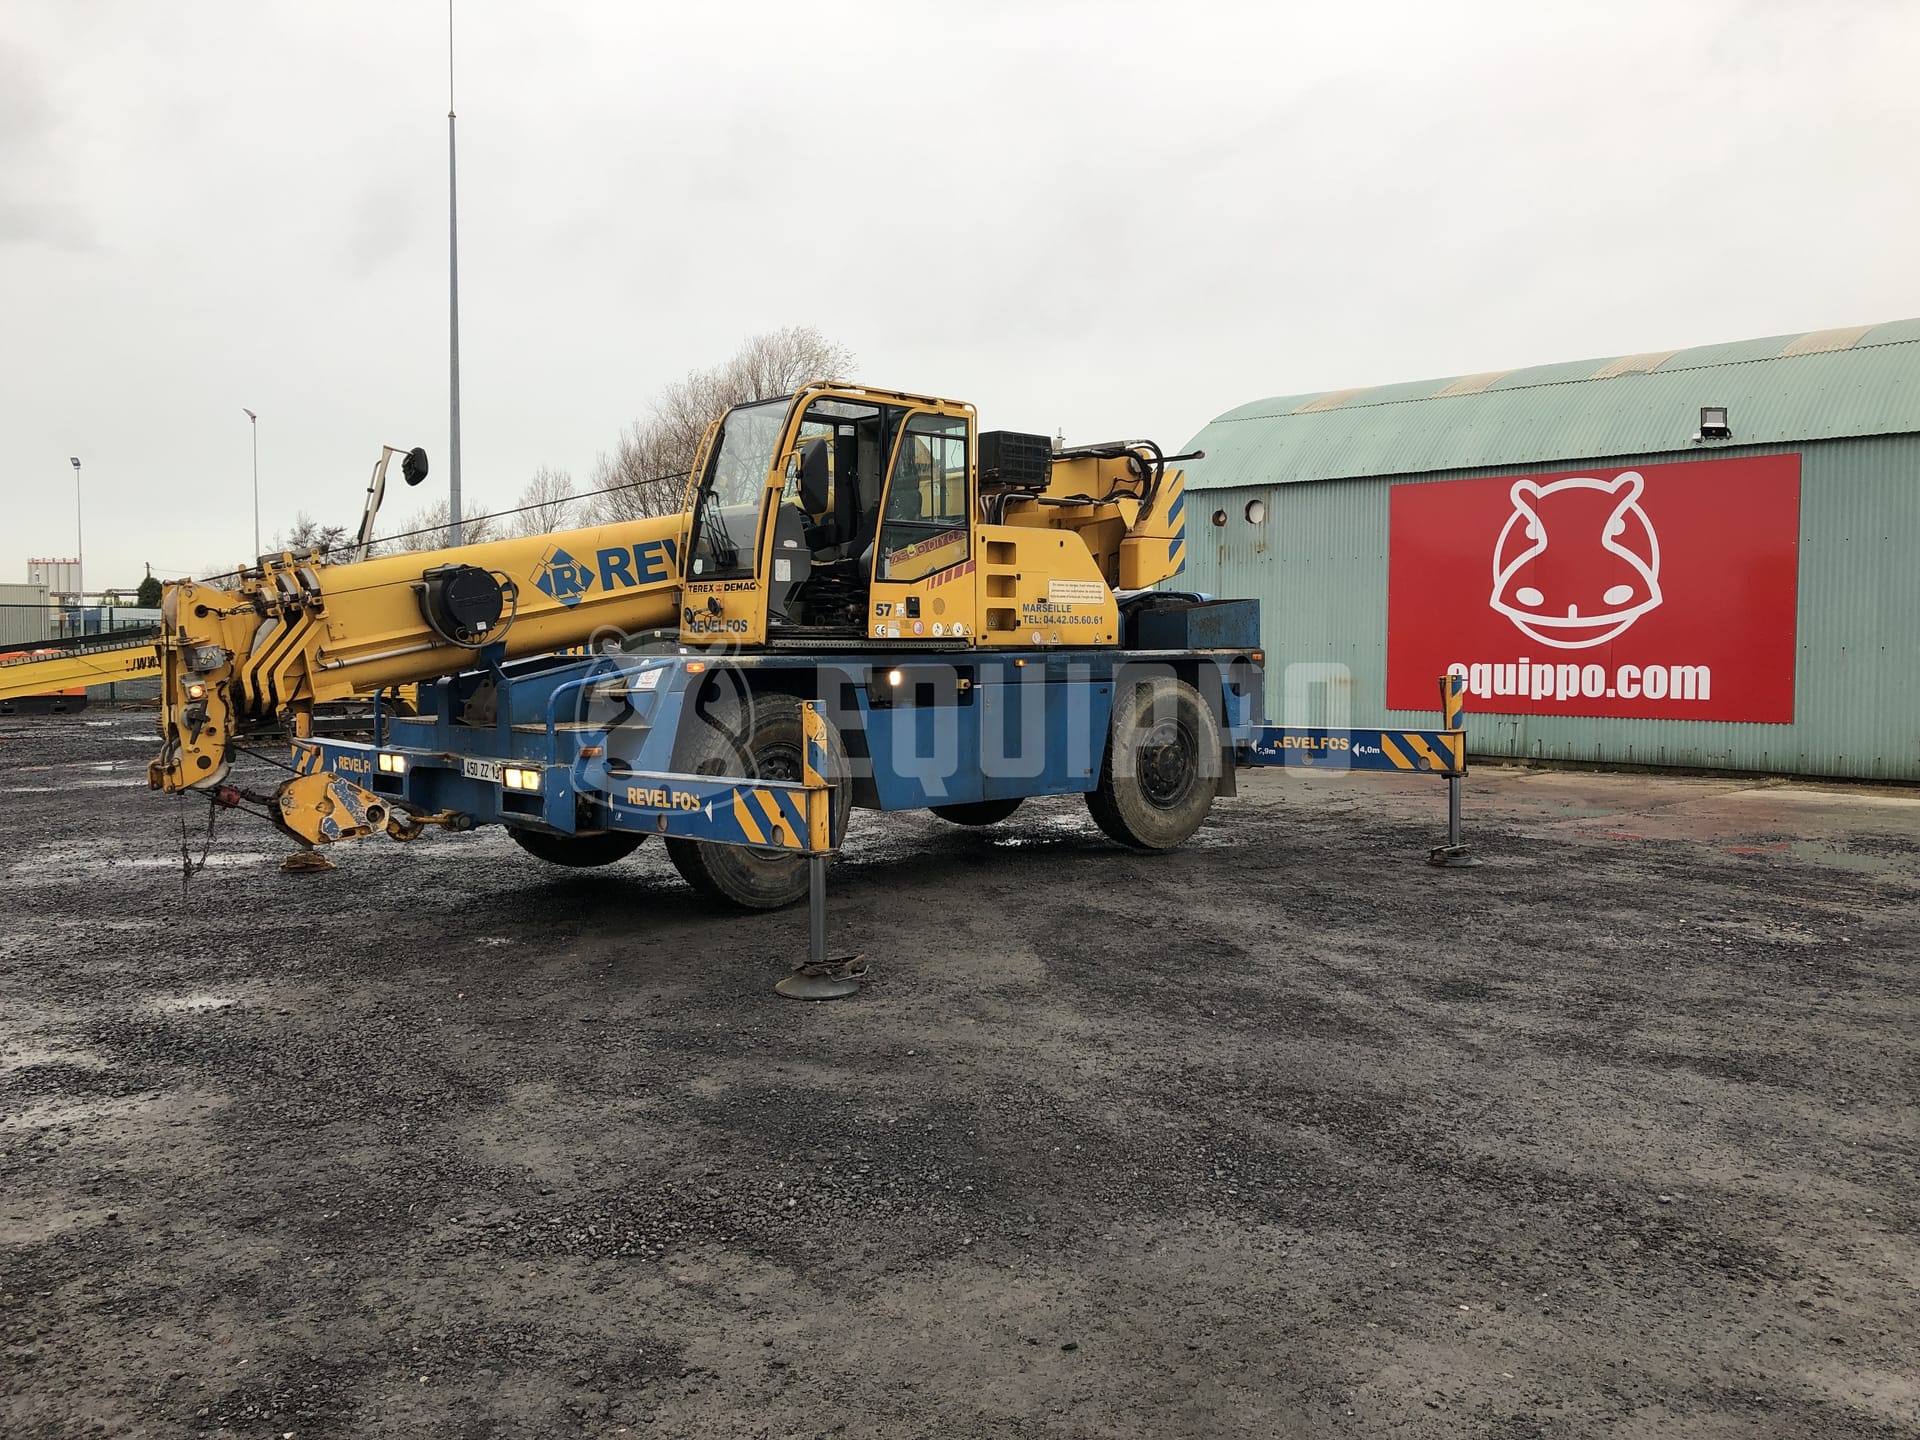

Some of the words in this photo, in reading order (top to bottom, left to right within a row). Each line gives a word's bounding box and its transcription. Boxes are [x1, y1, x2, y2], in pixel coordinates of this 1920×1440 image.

[688, 584, 714, 593] TEREX
[723, 582, 756, 592] DEMAG
[875, 603, 892, 617] 57
[1022, 603, 1072, 613] MARSEILLE
[690, 619, 724, 633] REVEL
[726, 619, 748, 633] FOS
[1447, 656, 1711, 701] equippo.com
[1320, 736, 1350, 751] FOS
[1360, 745, 1380, 755] 4,0m
[338, 755, 363, 774] REVEL
[480, 763, 489, 778] ZZ
[627, 787, 671, 809] REVEL
[672, 791, 701, 812] FOS
